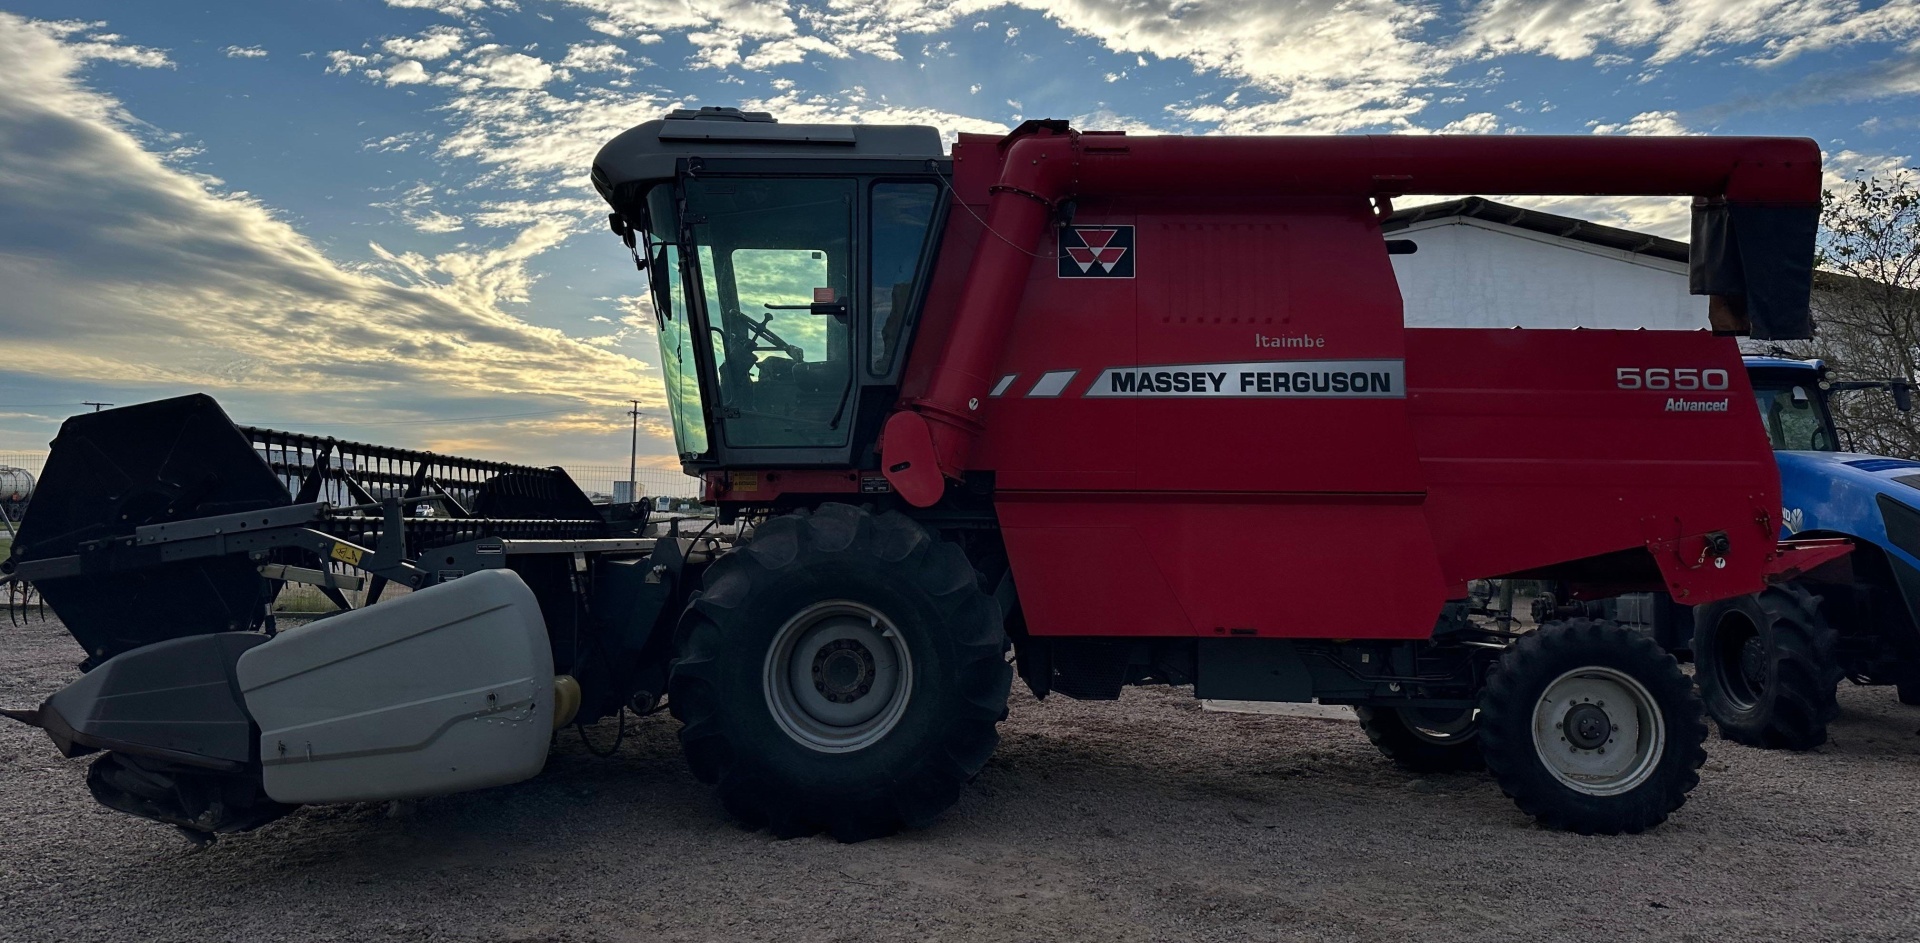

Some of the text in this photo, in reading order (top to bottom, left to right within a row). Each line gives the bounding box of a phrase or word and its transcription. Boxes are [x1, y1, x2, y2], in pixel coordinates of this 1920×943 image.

[1111, 372, 1391, 392] MASSEY FERGUSON
[1616, 367, 1729, 391] 5650
[1664, 398, 1728, 412] Advanced
